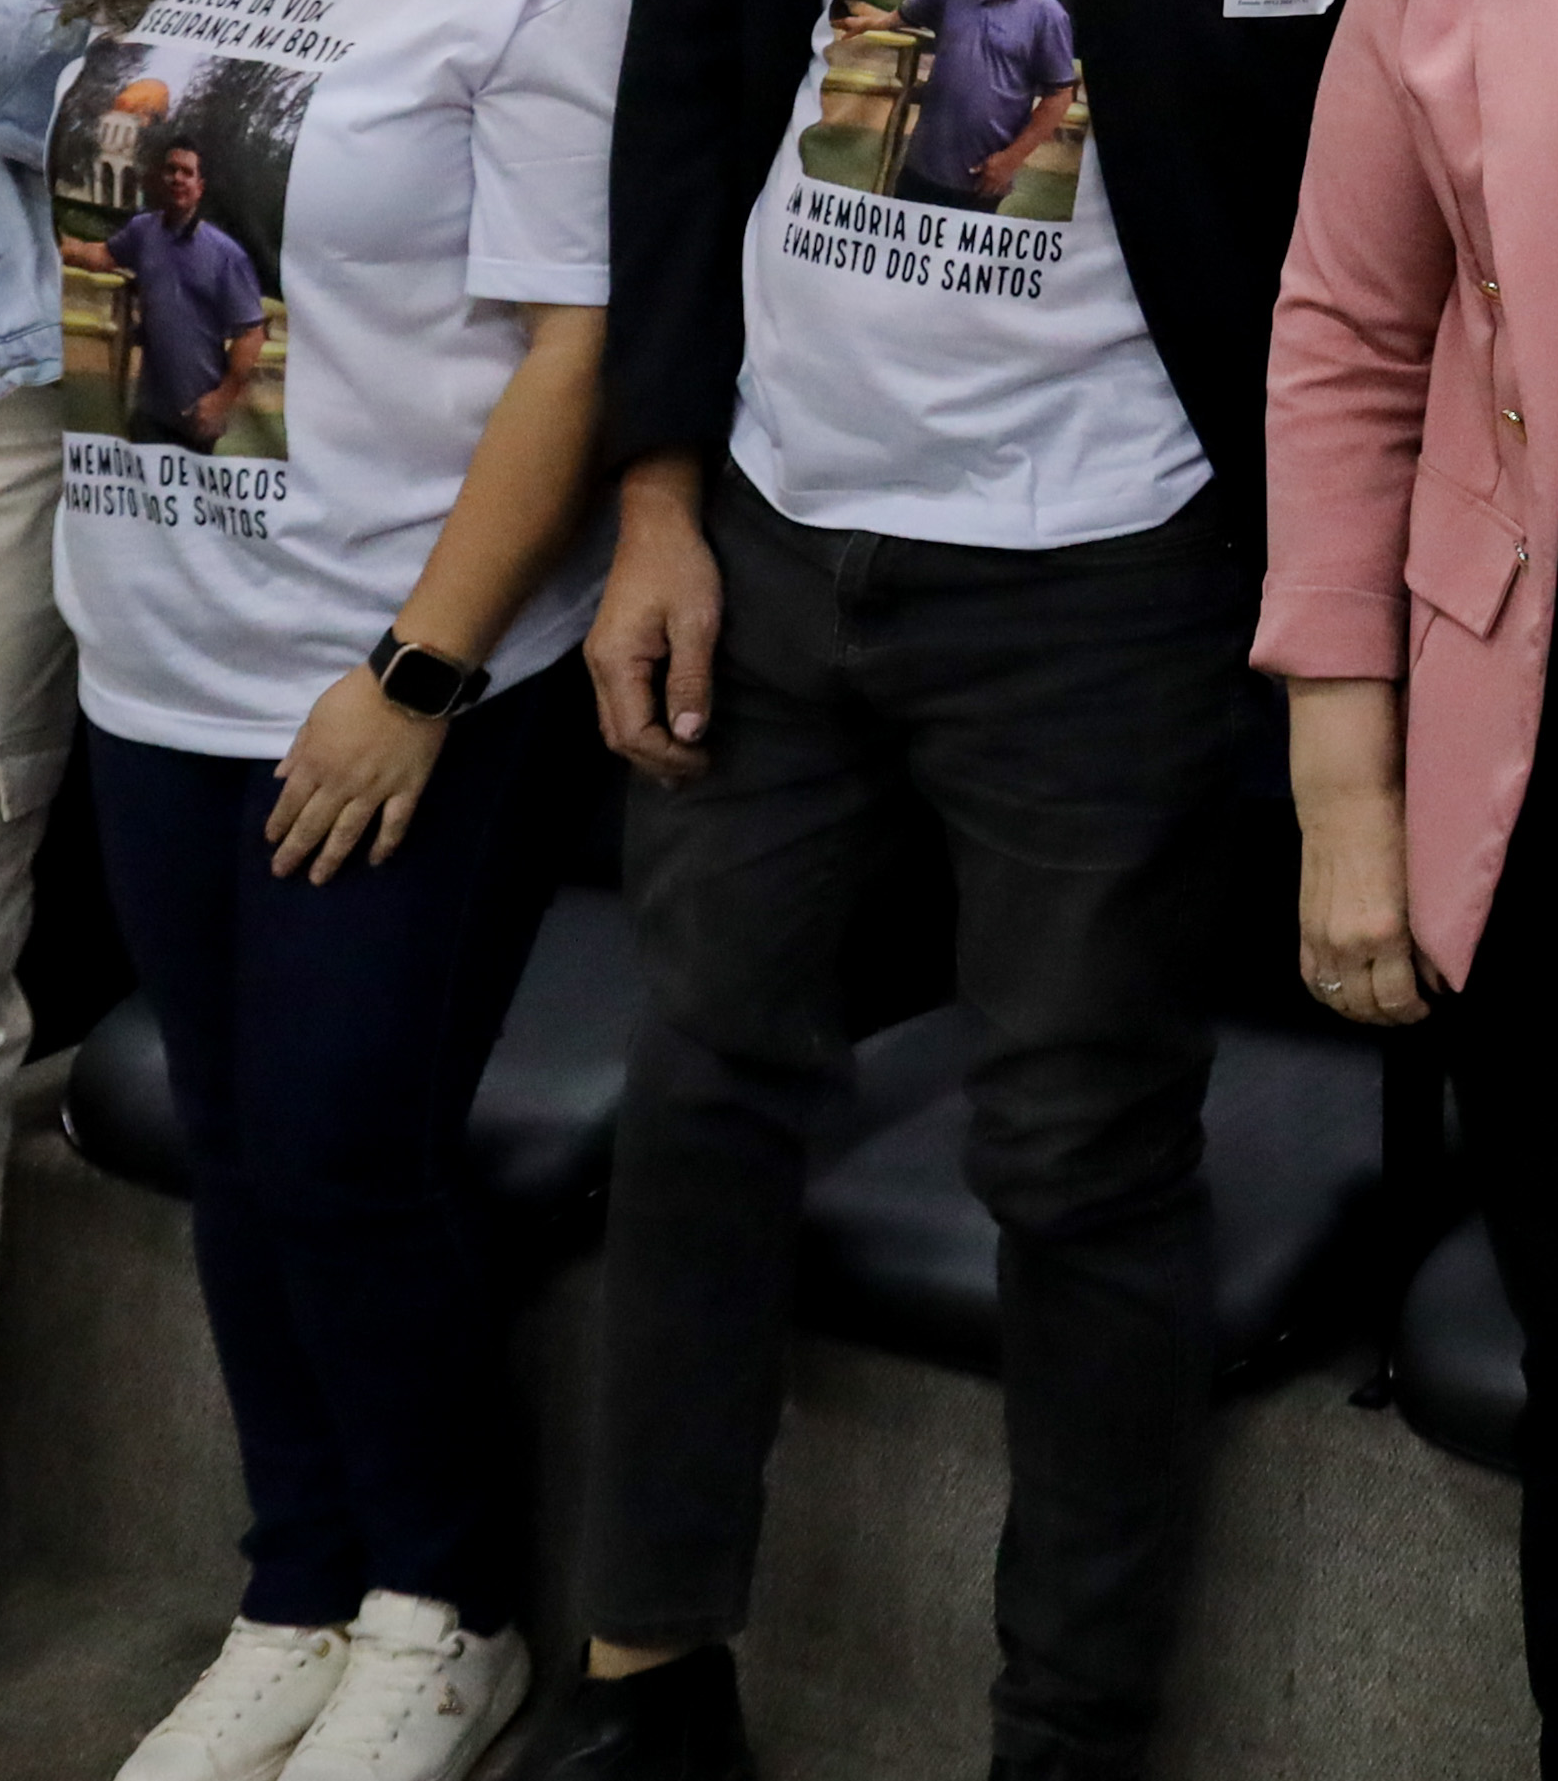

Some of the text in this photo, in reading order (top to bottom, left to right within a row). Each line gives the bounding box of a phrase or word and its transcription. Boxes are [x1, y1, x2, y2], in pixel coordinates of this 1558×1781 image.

[248, 25, 286, 50] NA
[807, 189, 906, 242] MEMÓRIA
[918, 214, 947, 248] DE
[958, 221, 1062, 263] MARCOS
[782, 223, 1042, 299] EVARISTO DOS SANTOS
[159, 455, 189, 487] DE
